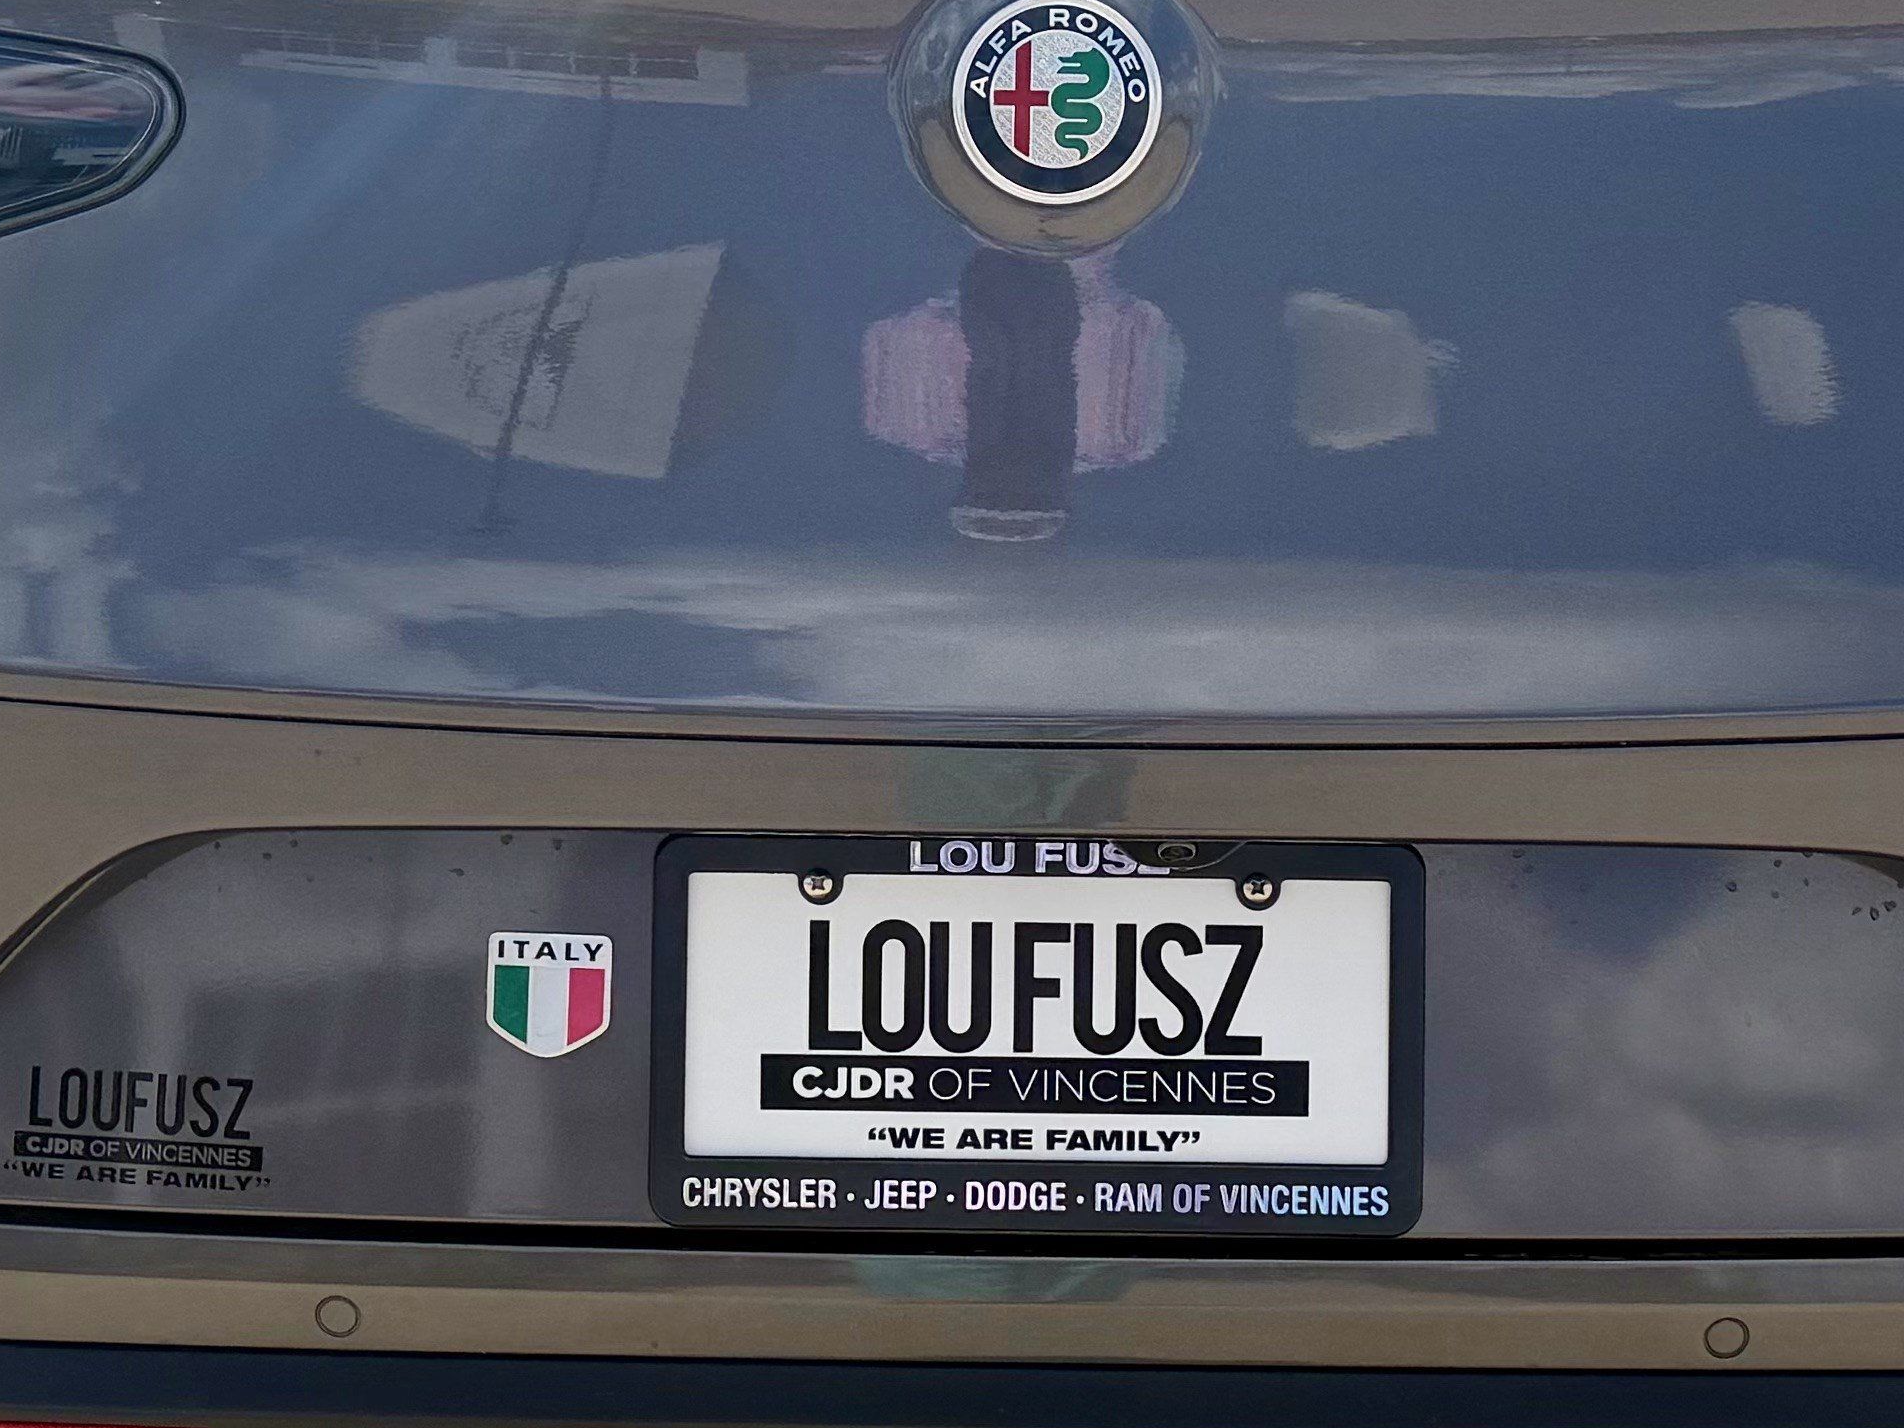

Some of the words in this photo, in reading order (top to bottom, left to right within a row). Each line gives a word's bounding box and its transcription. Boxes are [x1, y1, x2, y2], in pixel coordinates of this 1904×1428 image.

[969, 18, 1032, 99] ALFA
[1048, 8, 1146, 103] ROMEO
[909, 841, 1015, 873] LOU
[1035, 842, 1170, 875] FUS
[498, 940, 603, 961] ITALY
[808, 919, 992, 1054] LOU
[1013, 921, 1263, 1056] FUSZ
[792, 1066, 915, 1100] CJDR
[928, 1067, 992, 1101] OF
[1007, 1068, 1276, 1105] VINCENNES
[26, 1135, 85, 1157] CJDR
[89, 1140, 120, 1158] OF
[124, 1141, 252, 1168] VINCENNES
[956, 1128, 1033, 1151] ARE
[76, 1164, 137, 1185] ARE
[682, 1177, 837, 1209] CHRYSLER
[864, 1179, 937, 1210] JEEP
[965, 1181, 1067, 1212] DODGE
[1094, 1182, 1163, 1213] RAM
[1173, 1184, 1211, 1213] OF
[1219, 1184, 1390, 1216] VINCENNES
